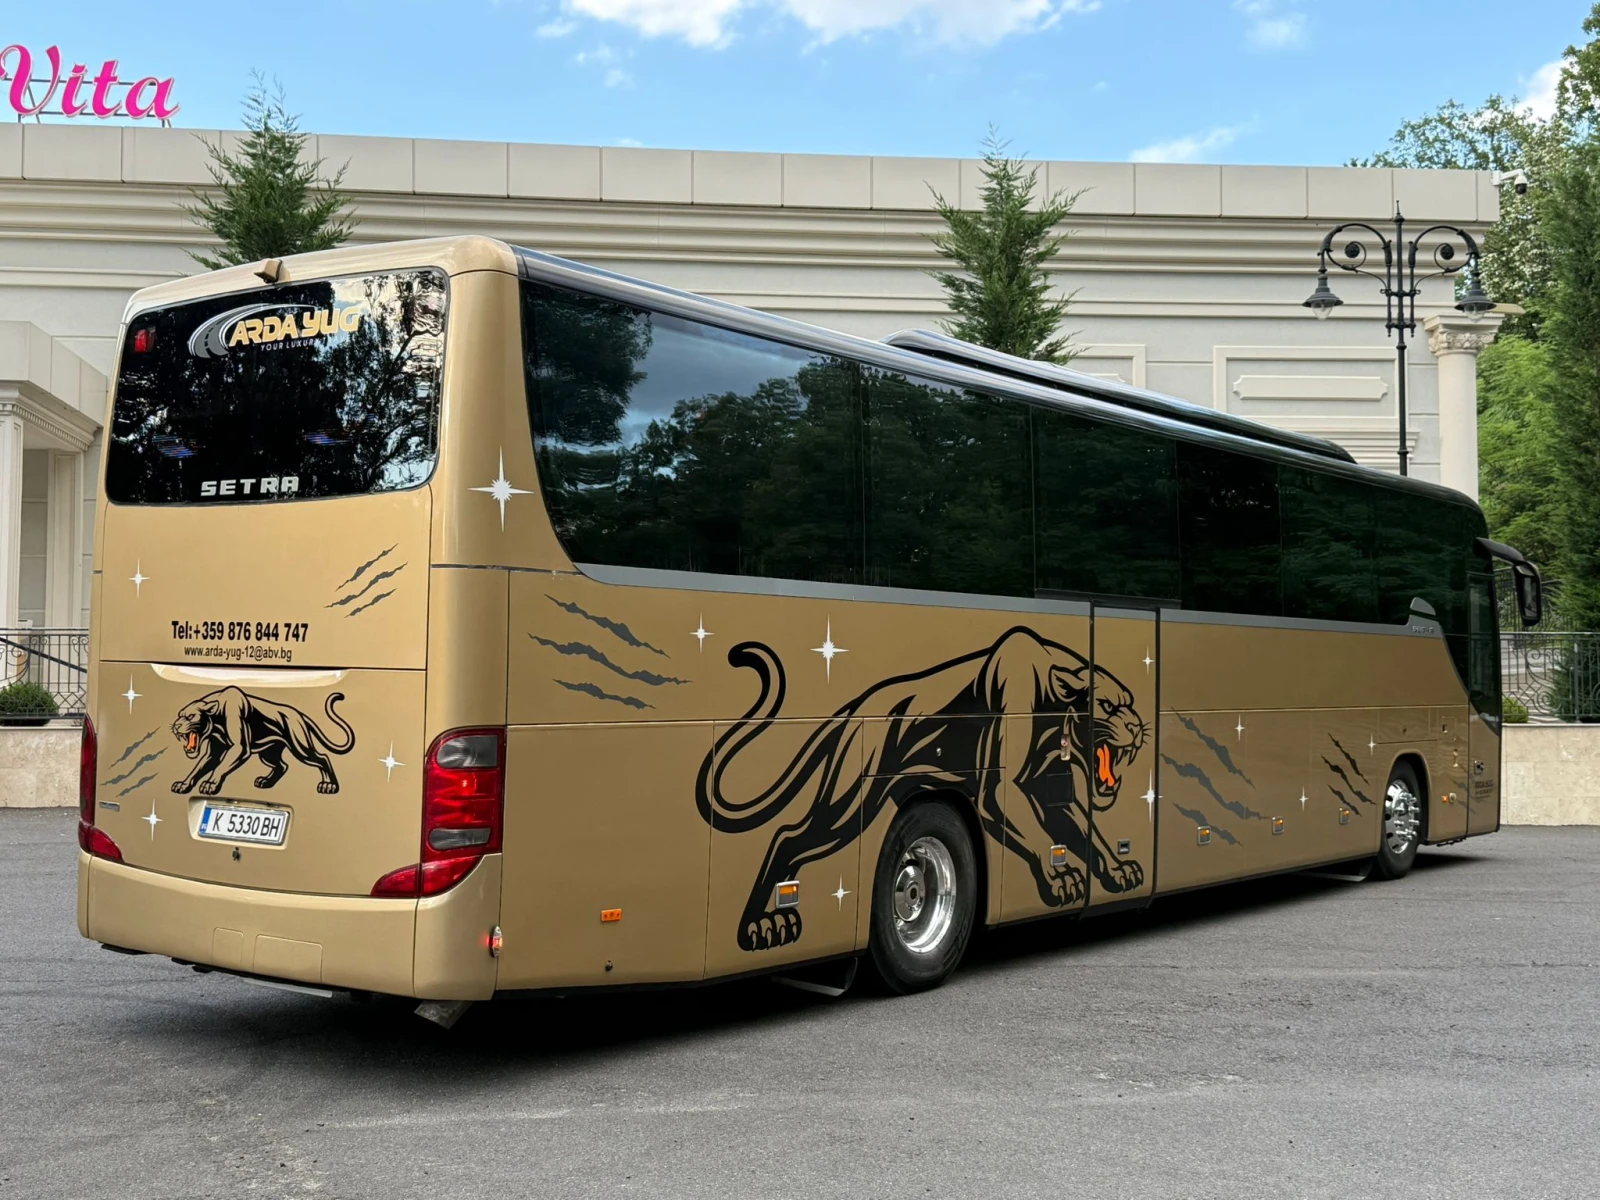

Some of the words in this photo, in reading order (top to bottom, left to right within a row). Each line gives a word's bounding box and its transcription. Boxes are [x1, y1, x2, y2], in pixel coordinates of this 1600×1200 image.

[0, 44, 180, 120] Vita
[229, 314, 298, 347] ARDA
[301, 306, 360, 337] YUG
[261, 342, 283, 351] YOUR
[200, 476, 299, 496] SETRA
[171, 620, 224, 641] Tel:+359
[228, 621, 251, 641] 876
[255, 622, 279, 642] 844
[284, 623, 308, 642] 747
[184, 645, 292, 662] www.arda-yug-12@abv.bg
